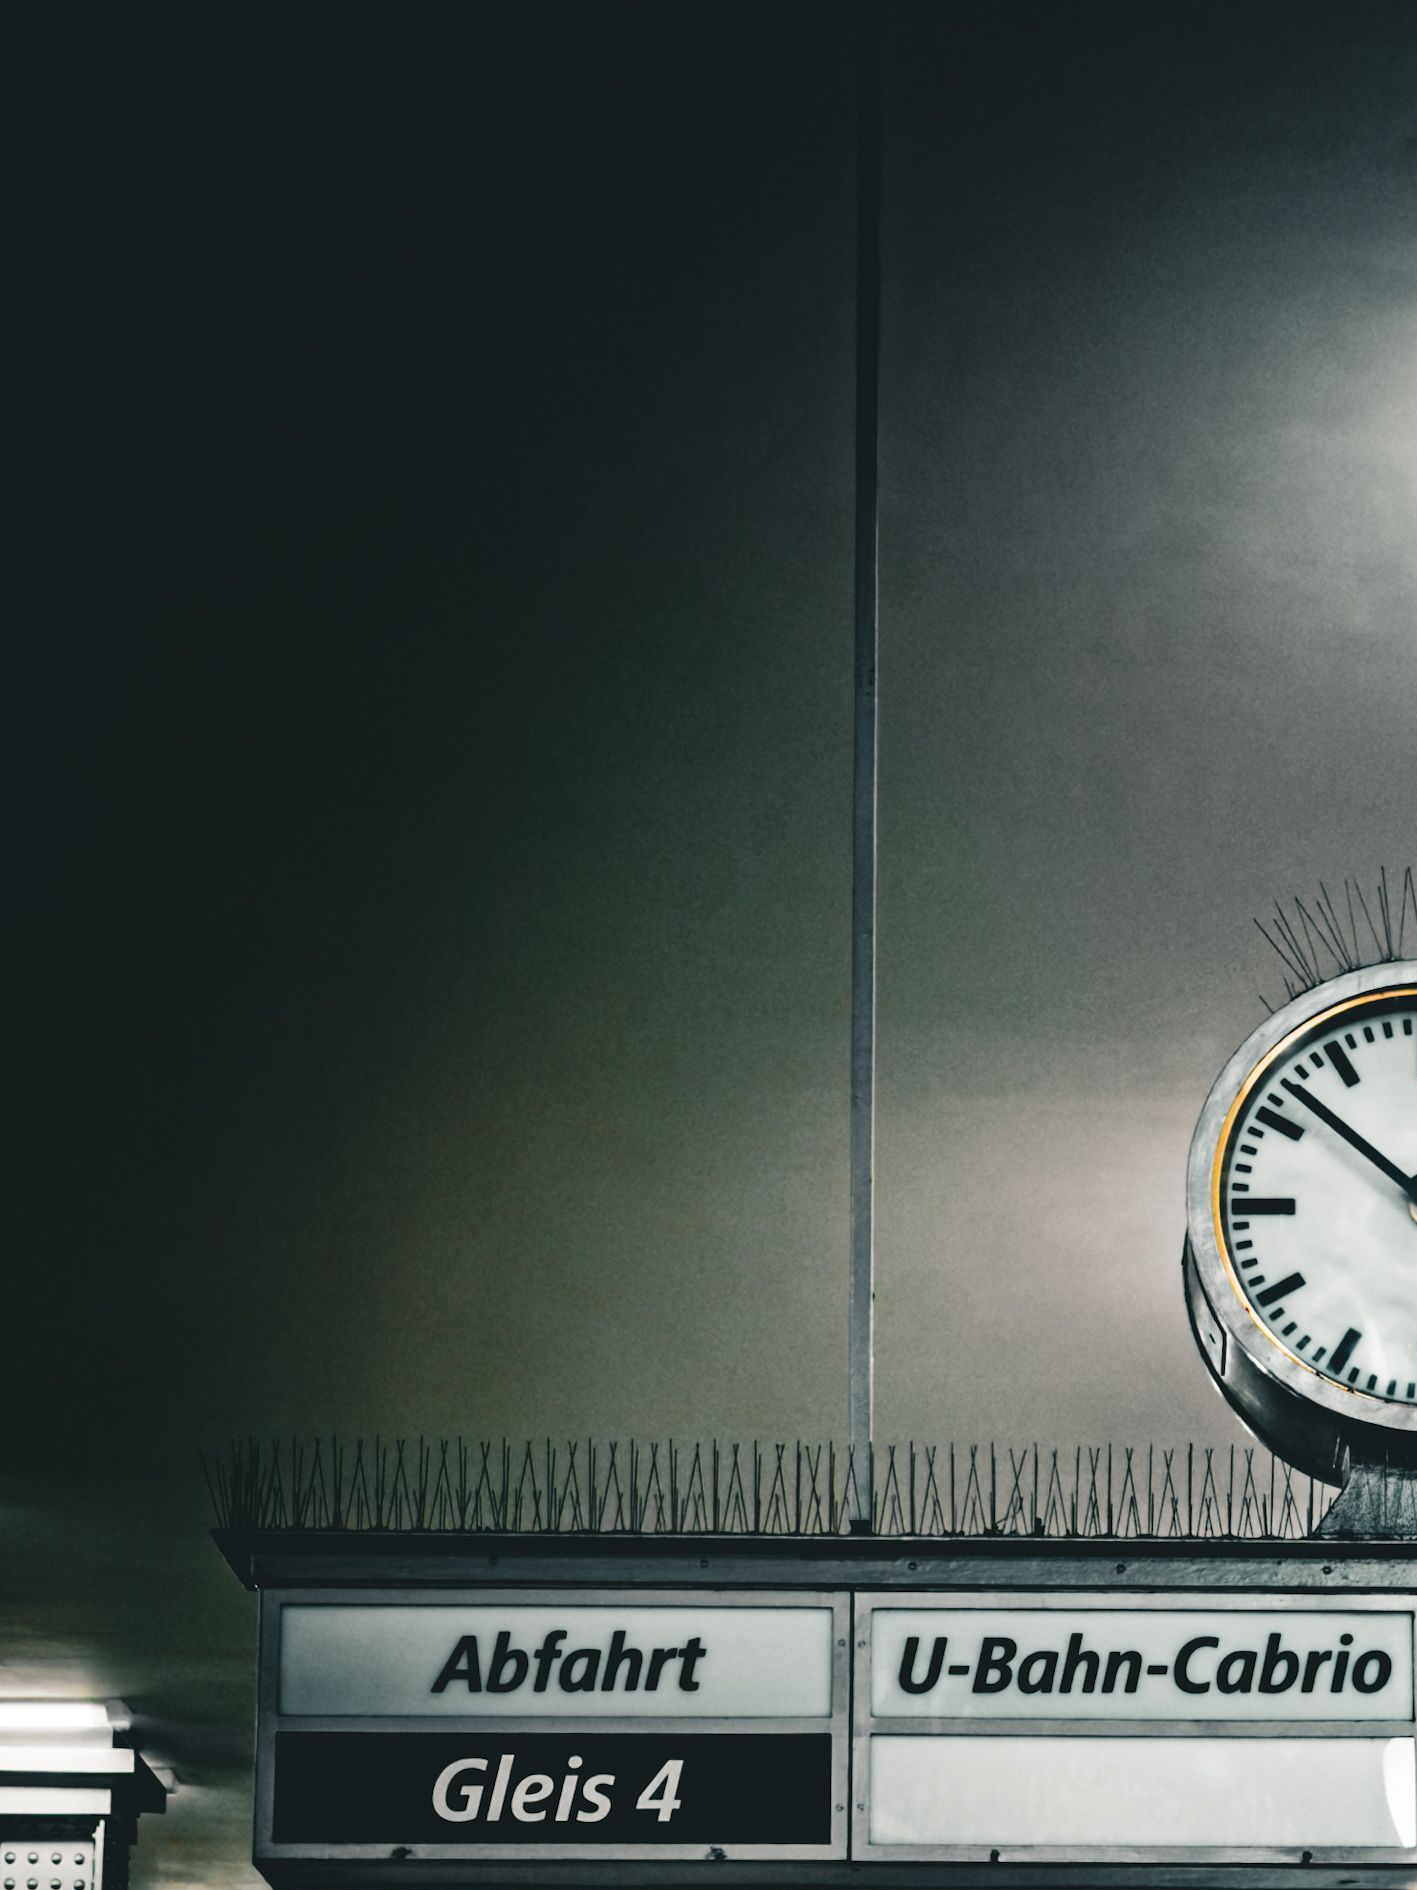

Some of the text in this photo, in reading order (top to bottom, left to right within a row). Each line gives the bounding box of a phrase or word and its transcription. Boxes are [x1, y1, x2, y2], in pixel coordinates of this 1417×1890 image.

[429, 1629, 707, 1696] Abfahrt
[898, 1632, 1392, 1695] U-Bahn-Cabrio
[432, 1754, 684, 1823] Gleis 4
